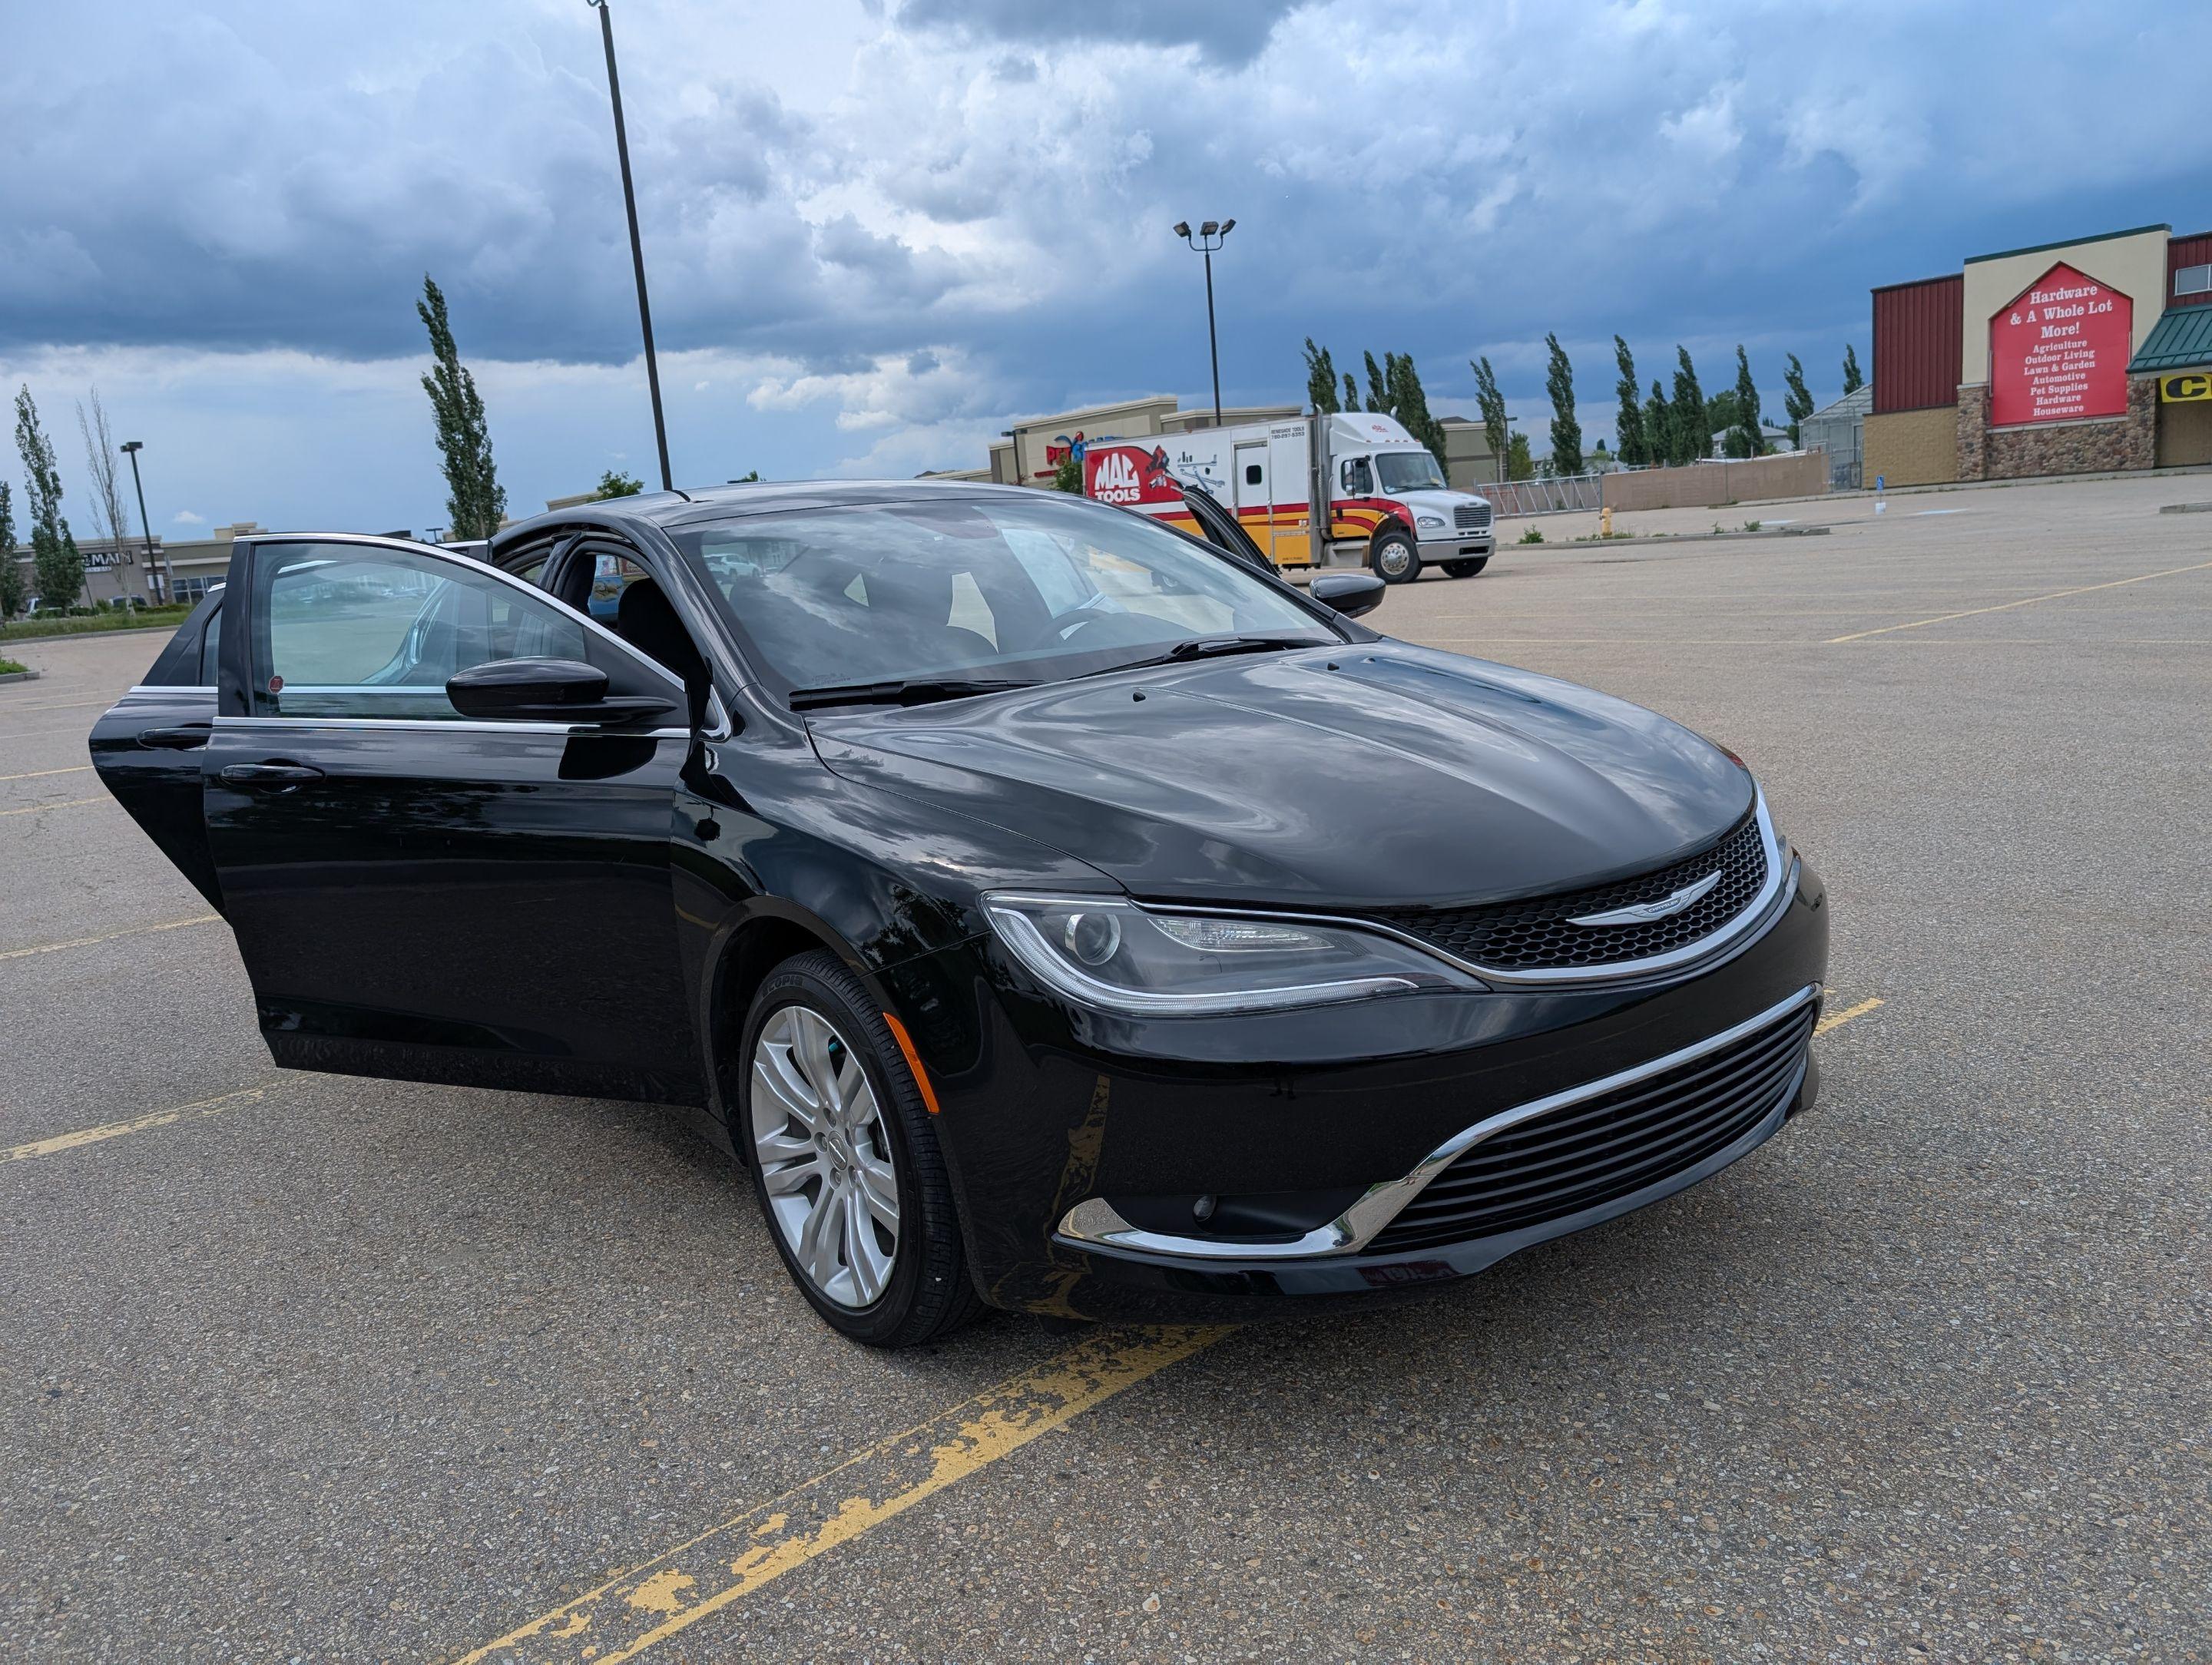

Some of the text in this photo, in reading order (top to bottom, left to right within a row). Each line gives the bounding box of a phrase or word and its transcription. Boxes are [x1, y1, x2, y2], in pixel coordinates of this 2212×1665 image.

[2030, 286, 2098, 305] Hardware
[2010, 299, 2112, 326] & A Whole Lot
[2041, 322, 2080, 339] More!
[2032, 340, 2088, 353] Agriculture
[2025, 349, 2094, 365] Outdoor Living
[2024, 360, 2095, 376] Lawn & Garden
[2032, 372, 2086, 385] Automotive
[2030, 382, 2088, 396] Pet Supplies
[2166, 376, 2212, 398] C
[2036, 394, 2081, 405] Hardware
[2033, 405, 2084, 416] Houseware
[1094, 452, 1141, 490] MAC
[1094, 488, 1141, 502] TOOLS
[1648, 899, 1679, 912] CHRYSLER
